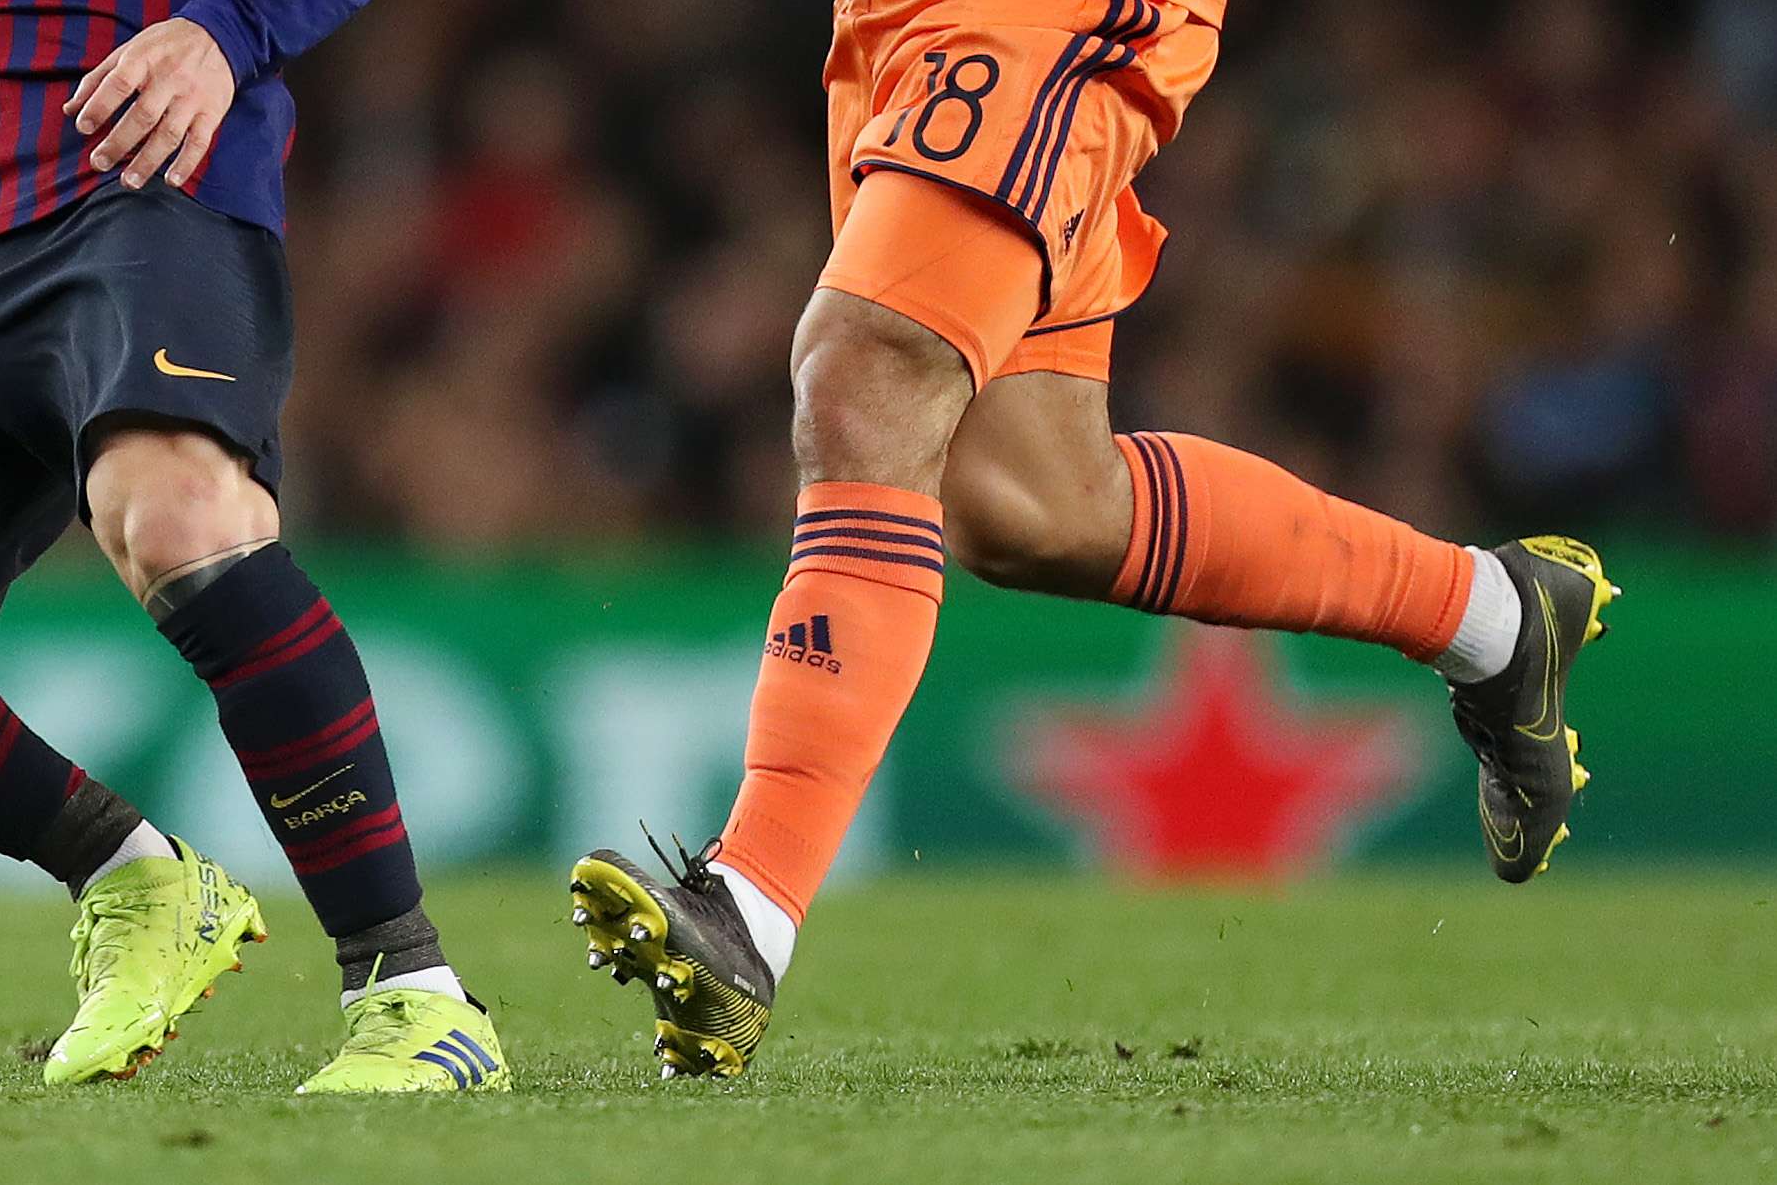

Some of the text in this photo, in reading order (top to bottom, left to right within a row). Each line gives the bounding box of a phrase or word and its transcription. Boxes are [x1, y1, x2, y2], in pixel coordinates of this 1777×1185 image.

[883, 51, 1000, 162] 18
[763, 638, 843, 675] adidas
[284, 790, 367, 830] BARÇA
